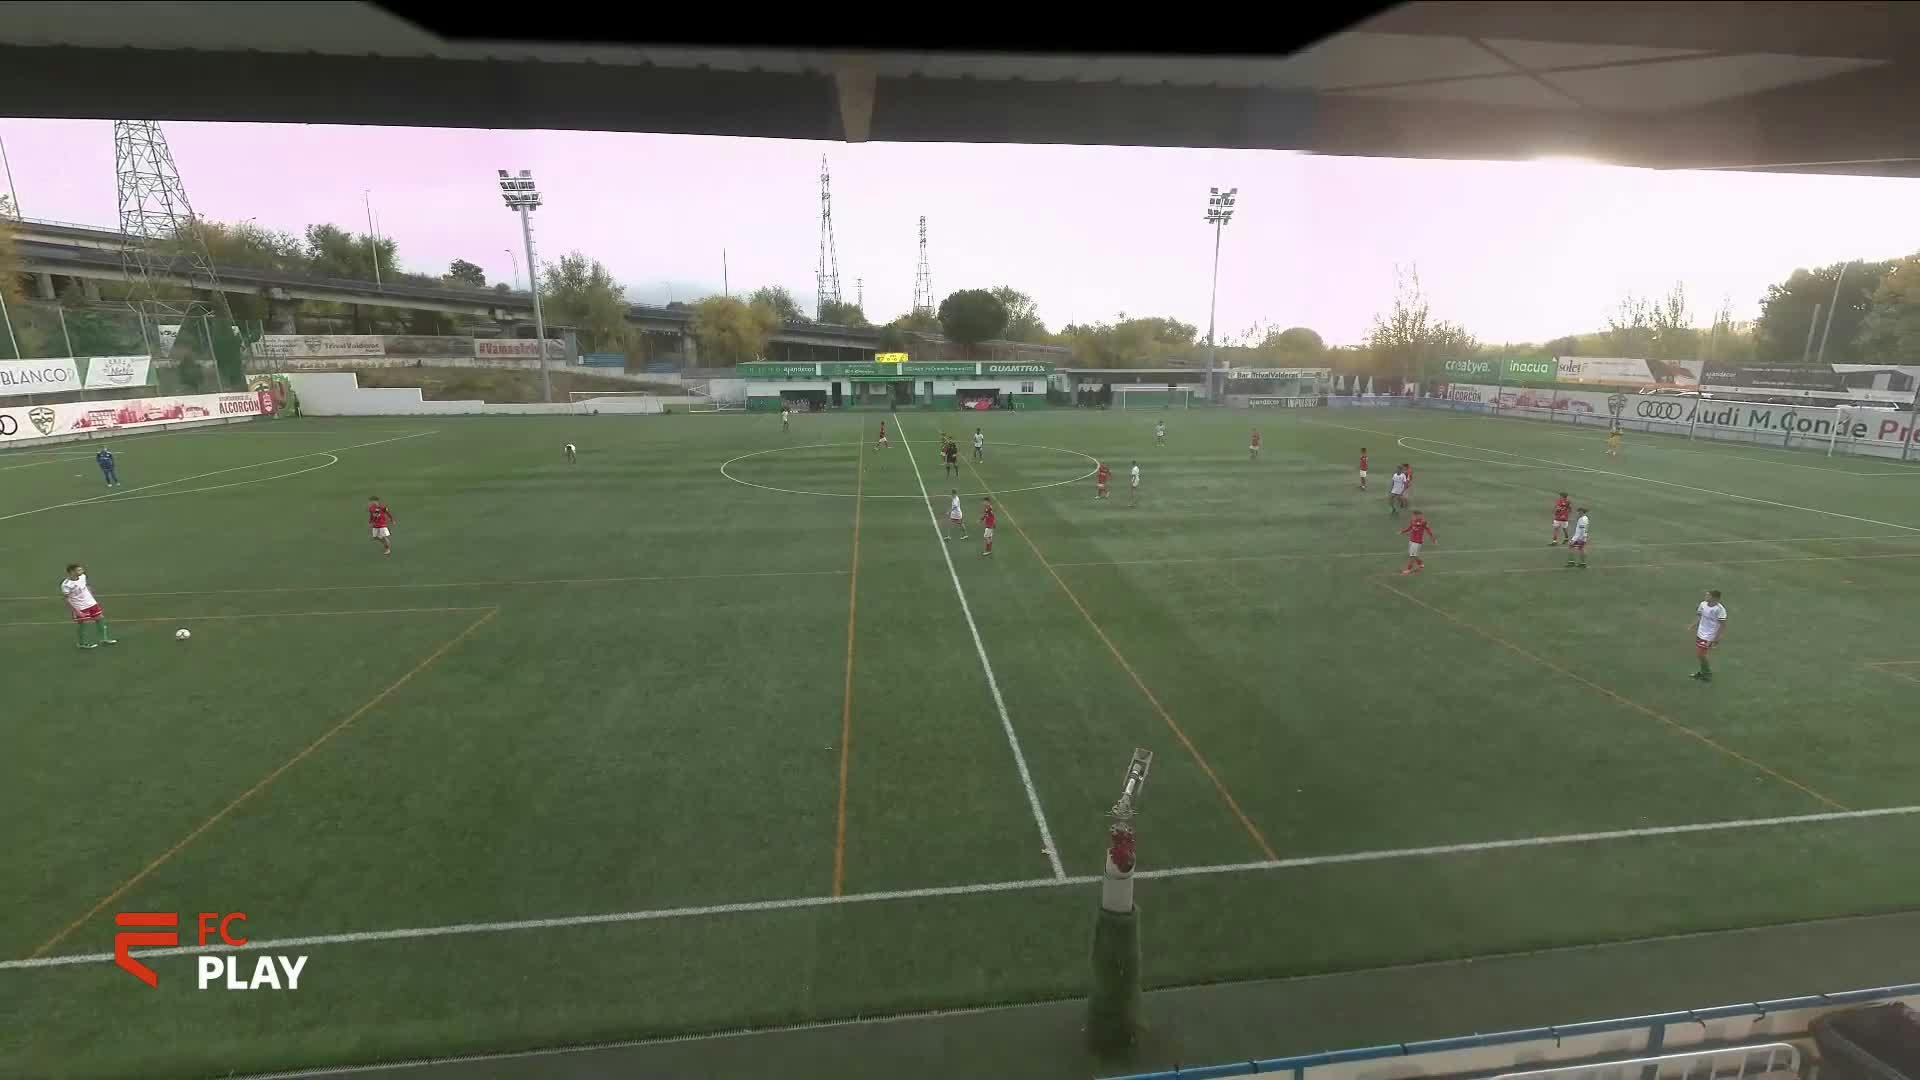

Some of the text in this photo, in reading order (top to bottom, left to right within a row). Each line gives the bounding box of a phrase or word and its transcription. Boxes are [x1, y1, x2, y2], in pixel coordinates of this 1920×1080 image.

[1510, 360, 1549, 373] inacua
[1447, 390, 1482, 402] ACORCÓN
[219, 398, 260, 414] ALCORCÓN
[1686, 407, 1741, 426] Audi
